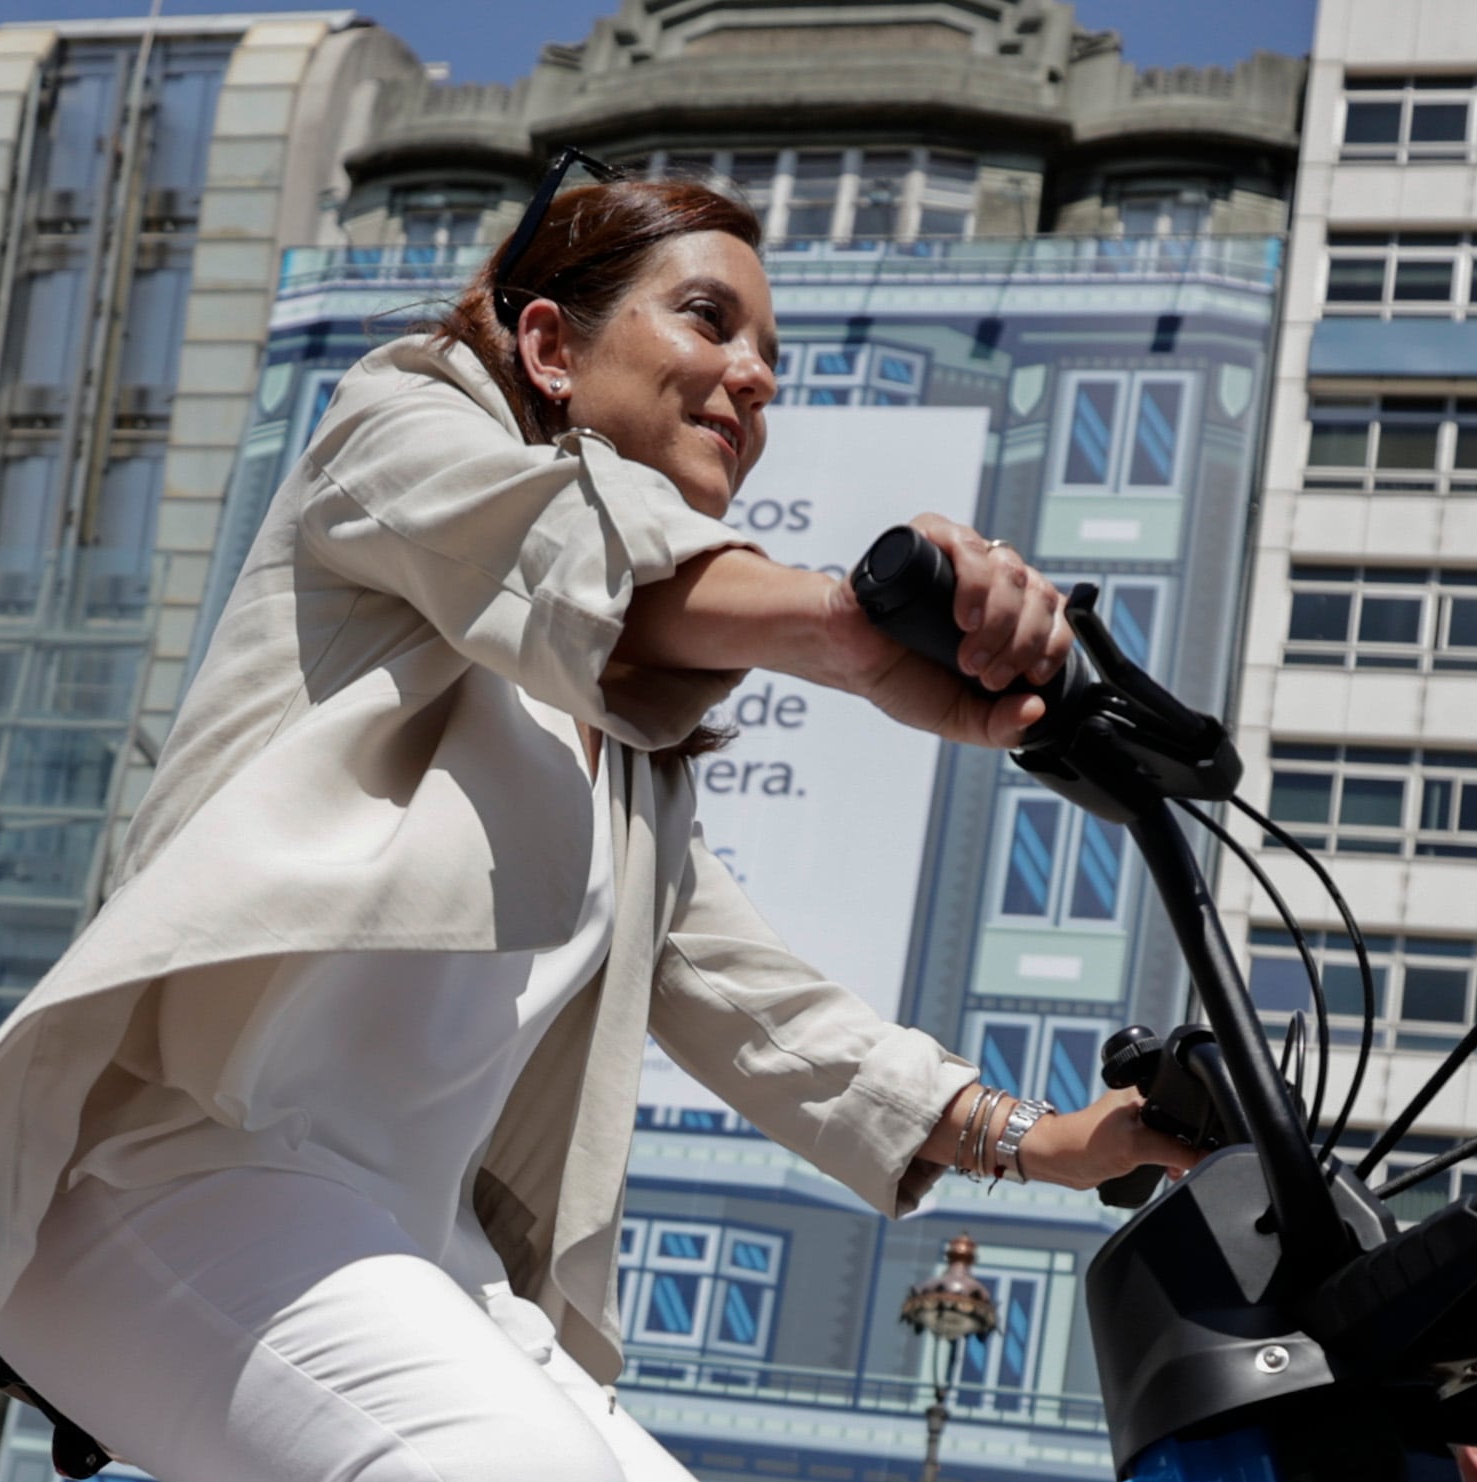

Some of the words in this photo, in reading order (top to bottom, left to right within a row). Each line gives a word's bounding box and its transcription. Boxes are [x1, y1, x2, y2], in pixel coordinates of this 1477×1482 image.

[727, 498, 813, 533] cos
[735, 682, 808, 729] de
[692, 757, 807, 798] era.
